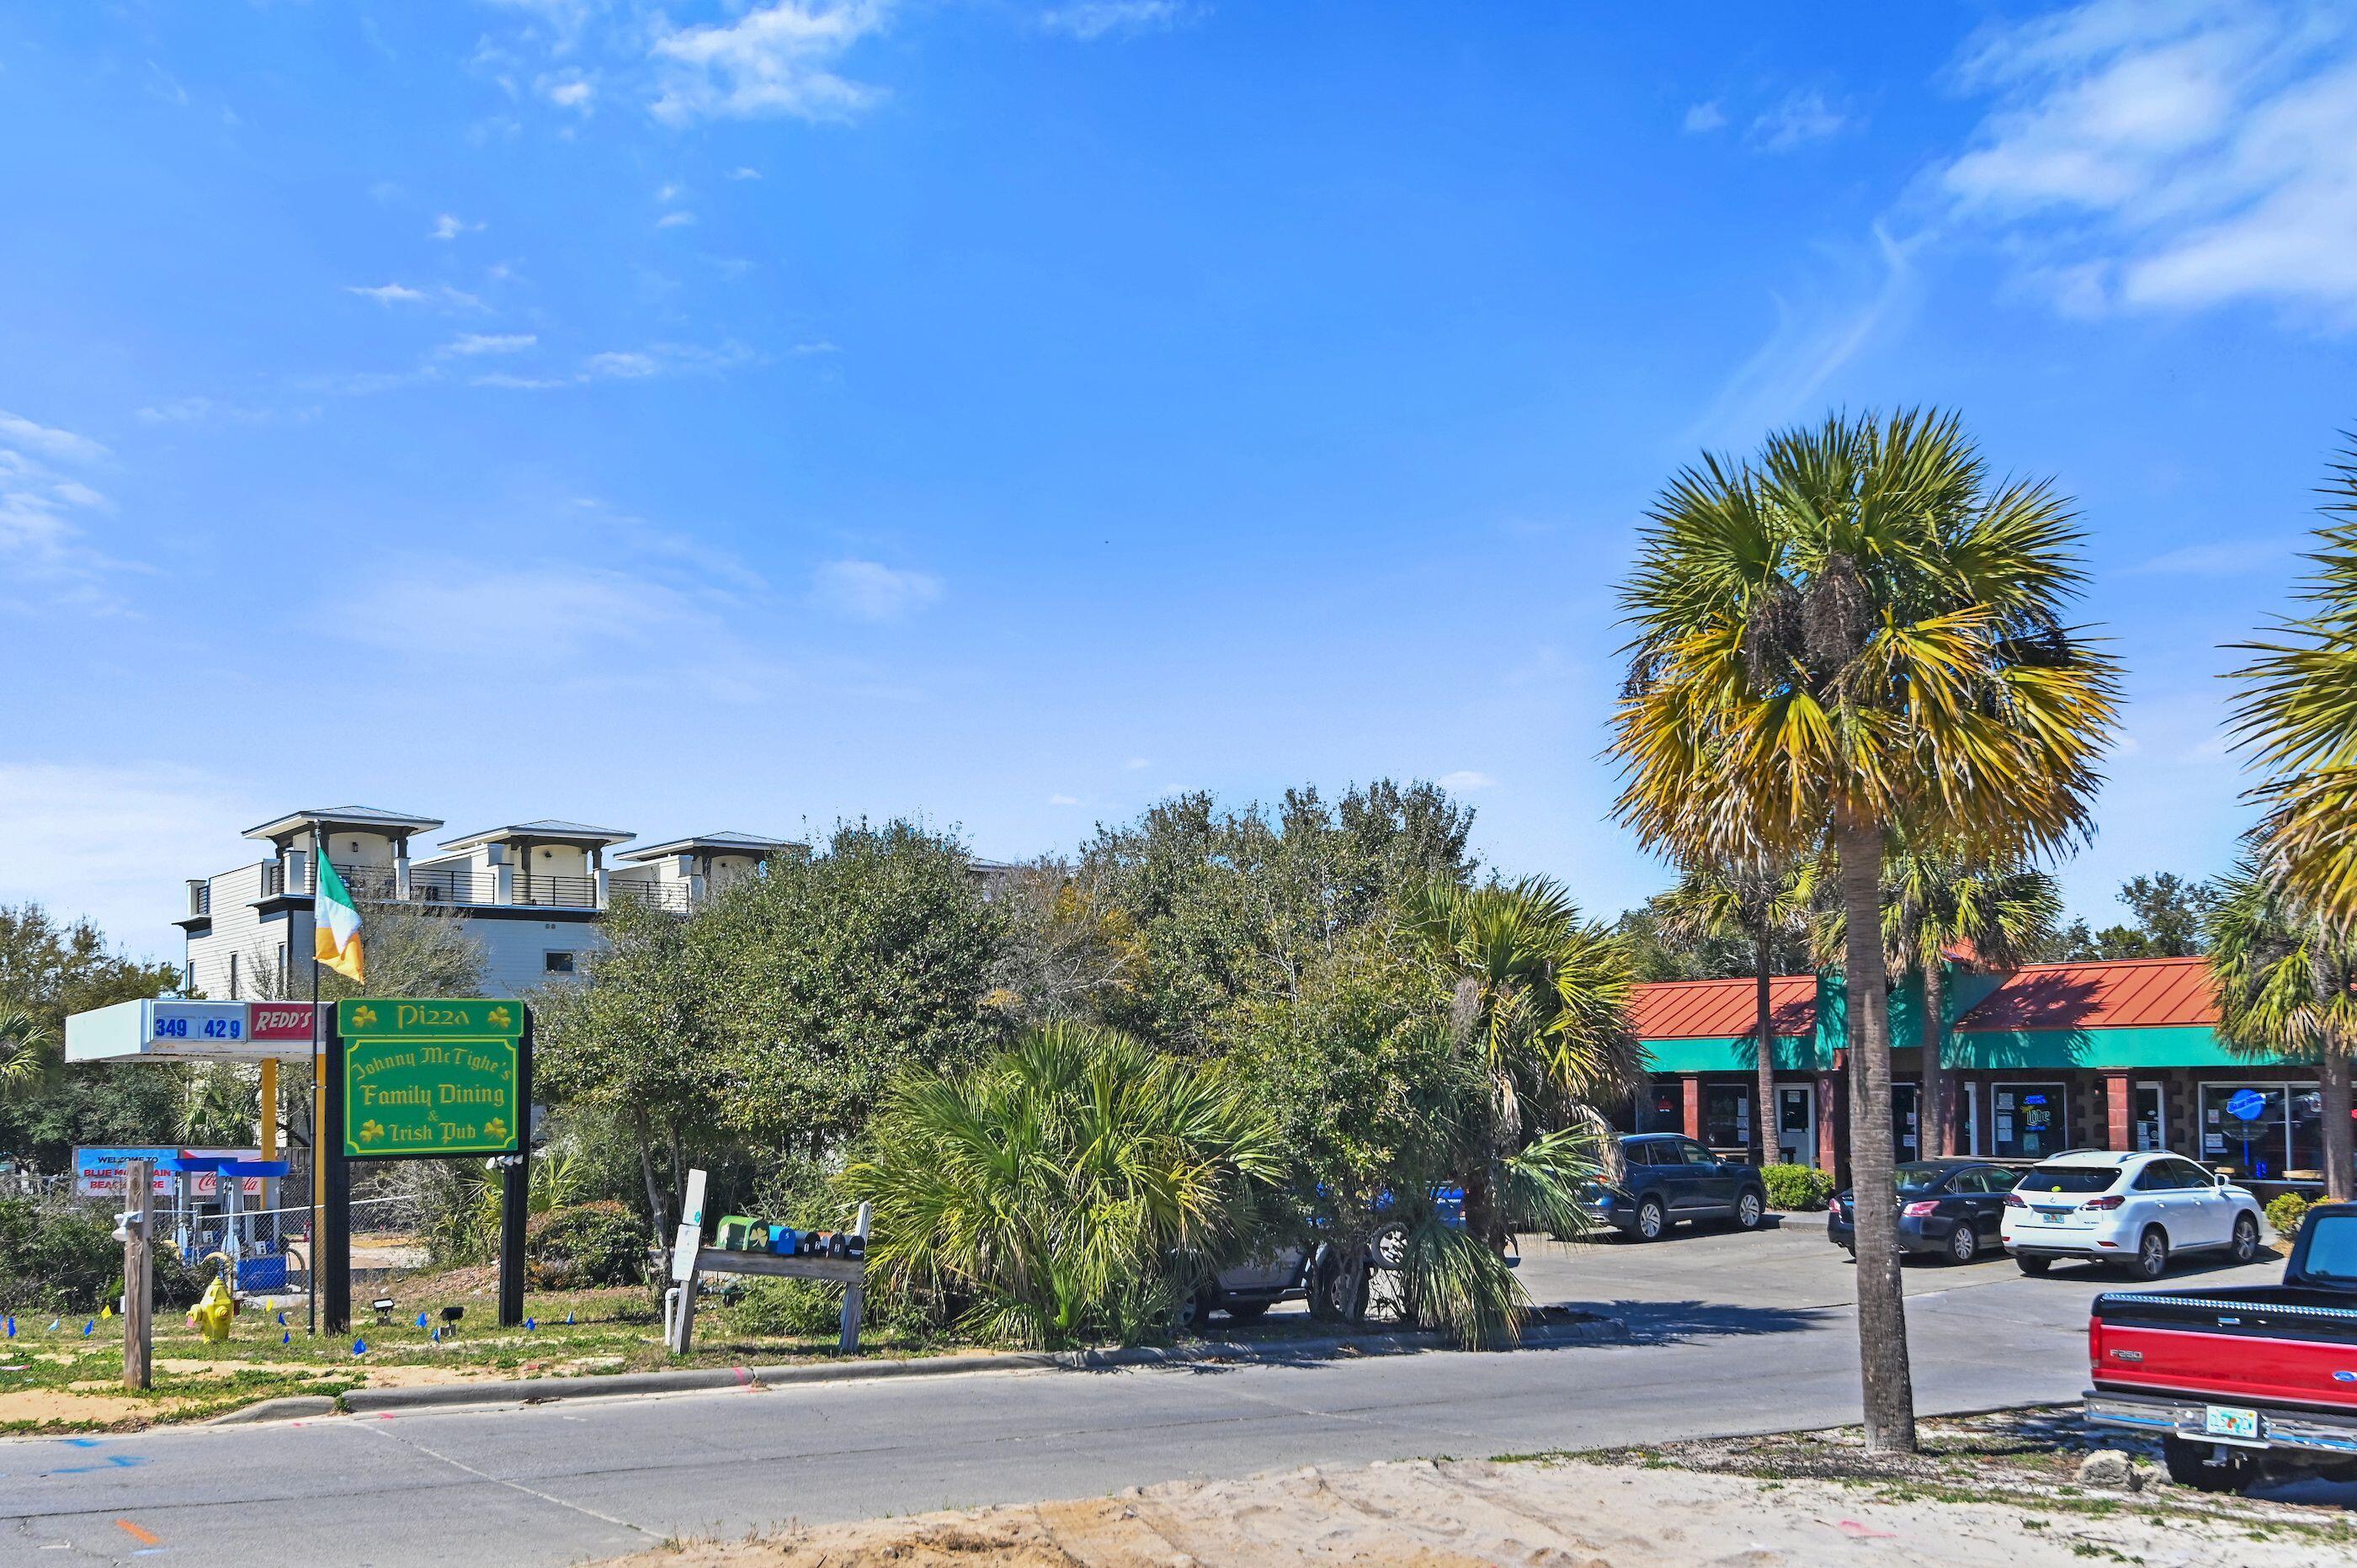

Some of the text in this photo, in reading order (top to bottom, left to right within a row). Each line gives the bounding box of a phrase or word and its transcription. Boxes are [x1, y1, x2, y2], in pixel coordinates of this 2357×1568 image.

[156, 1018, 187, 1036] 349
[255, 1011, 313, 1032] REDD'S
[397, 1005, 470, 1029] Pizza
[351, 1047, 512, 1081] Johnny McTighe's
[359, 1084, 505, 1107] Family Dining
[428, 1109, 439, 1122] &
[387, 1122, 476, 1145] Irish Pub
[2110, 1349, 2142, 1358] F250
